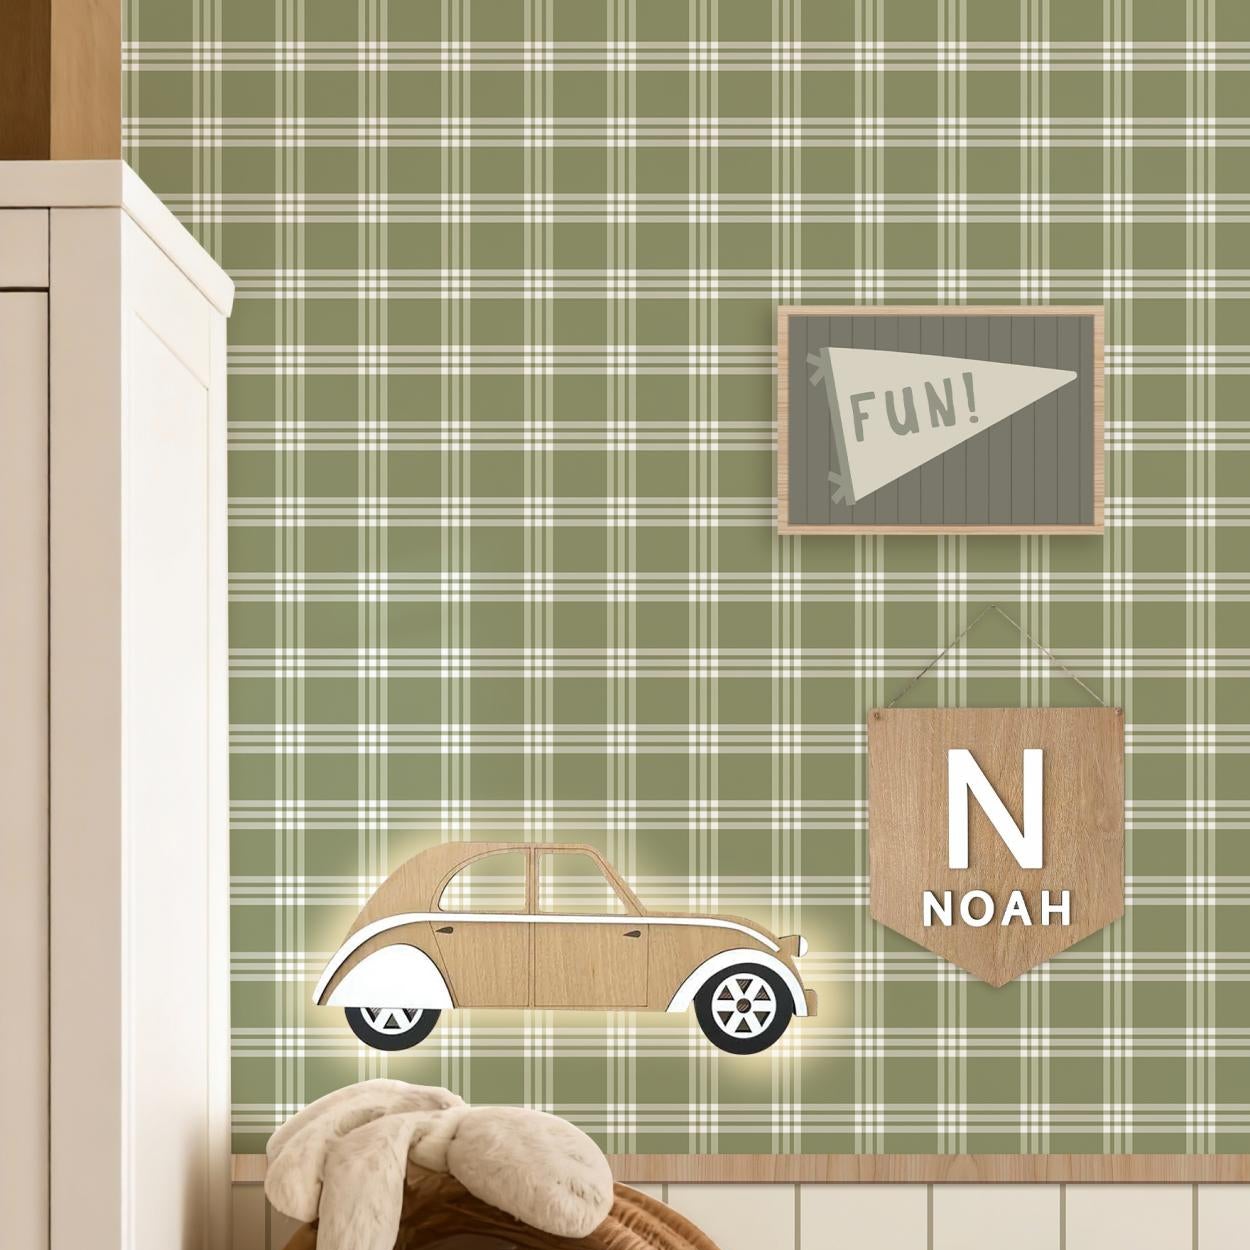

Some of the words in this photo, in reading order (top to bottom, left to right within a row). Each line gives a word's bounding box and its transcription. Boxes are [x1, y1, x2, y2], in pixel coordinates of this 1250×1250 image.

[850, 371, 979, 442] FUN!
[948, 748, 1043, 869] N
[923, 890, 1070, 927] NOAH
